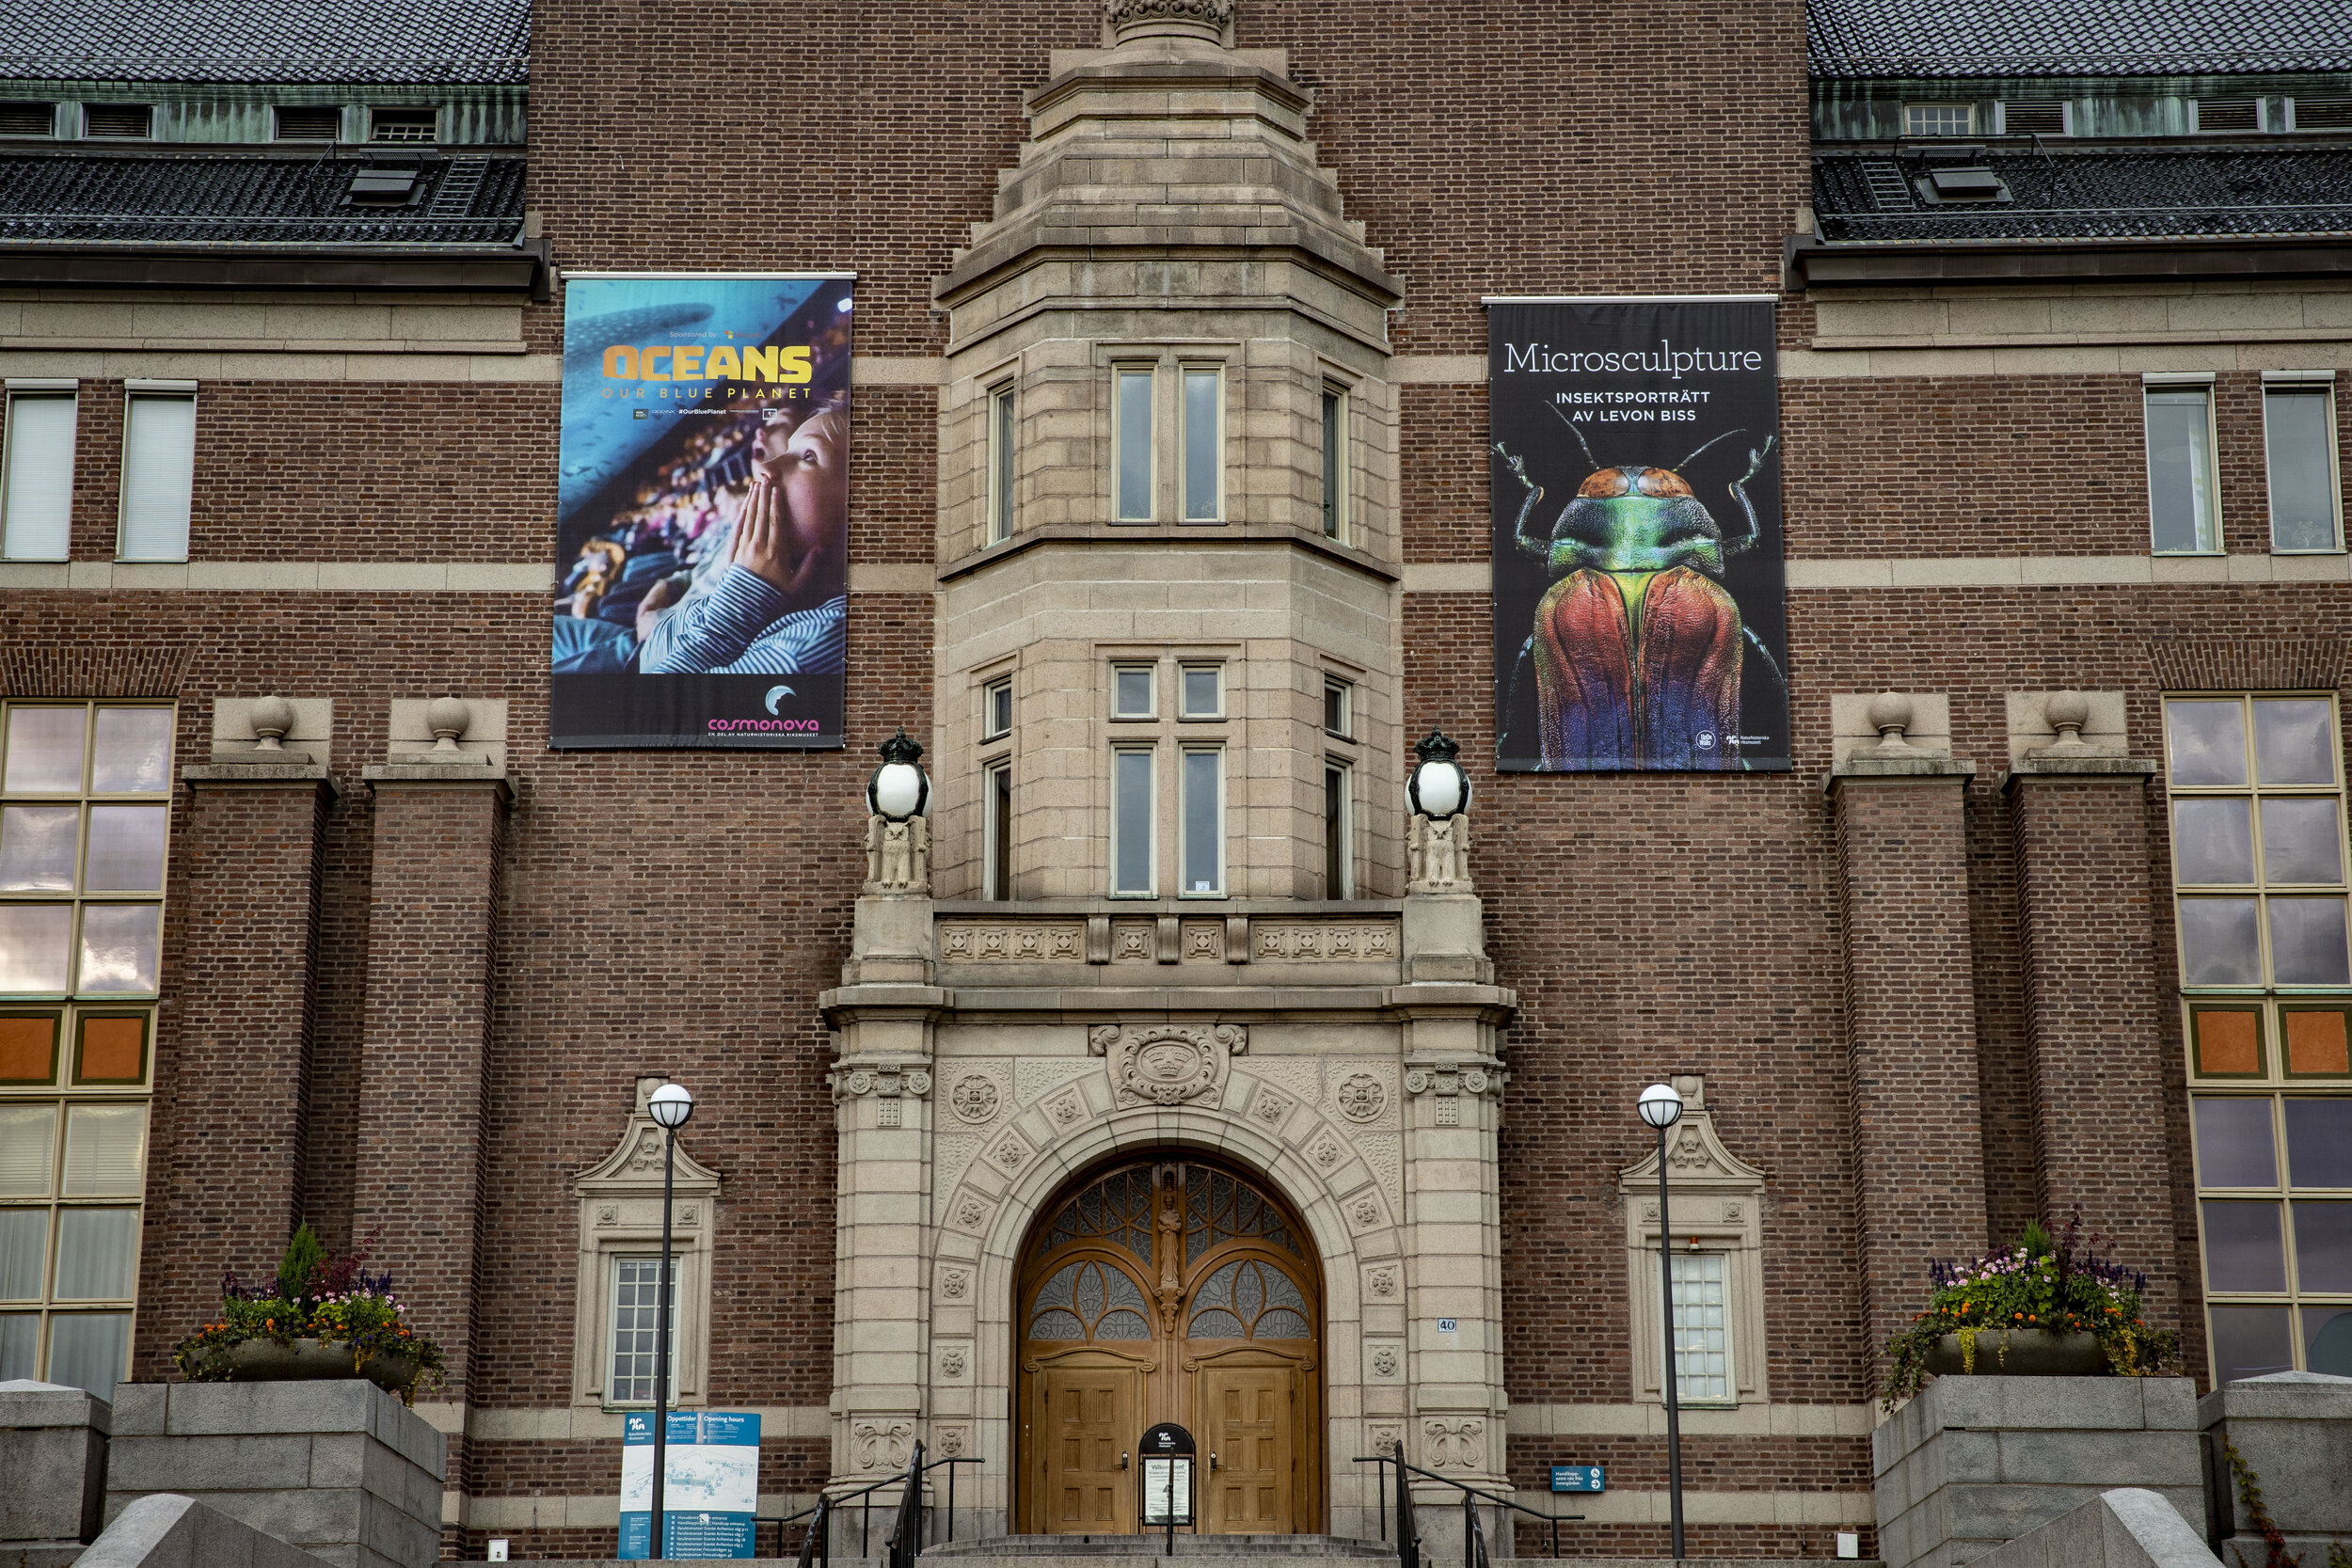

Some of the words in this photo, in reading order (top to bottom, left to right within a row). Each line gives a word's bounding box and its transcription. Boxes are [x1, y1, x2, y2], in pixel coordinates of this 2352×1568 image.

[708, 331, 718, 340] by
[603, 345, 812, 384] OCEANS
[1504, 340, 1762, 379] Microsculpture
[602, 388, 645, 399] OUR
[660, 388, 713, 399] BLUE
[727, 388, 812, 399] PLANET
[1556, 389, 1710, 404] INSEKTSPORTRÄTT
[1572, 411, 1594, 421] AV
[1600, 410, 1655, 421] LEVON
[1661, 410, 1696, 421] BISS
[707, 719, 819, 731] cosmonova
[1440, 1321, 1454, 1330] 40
